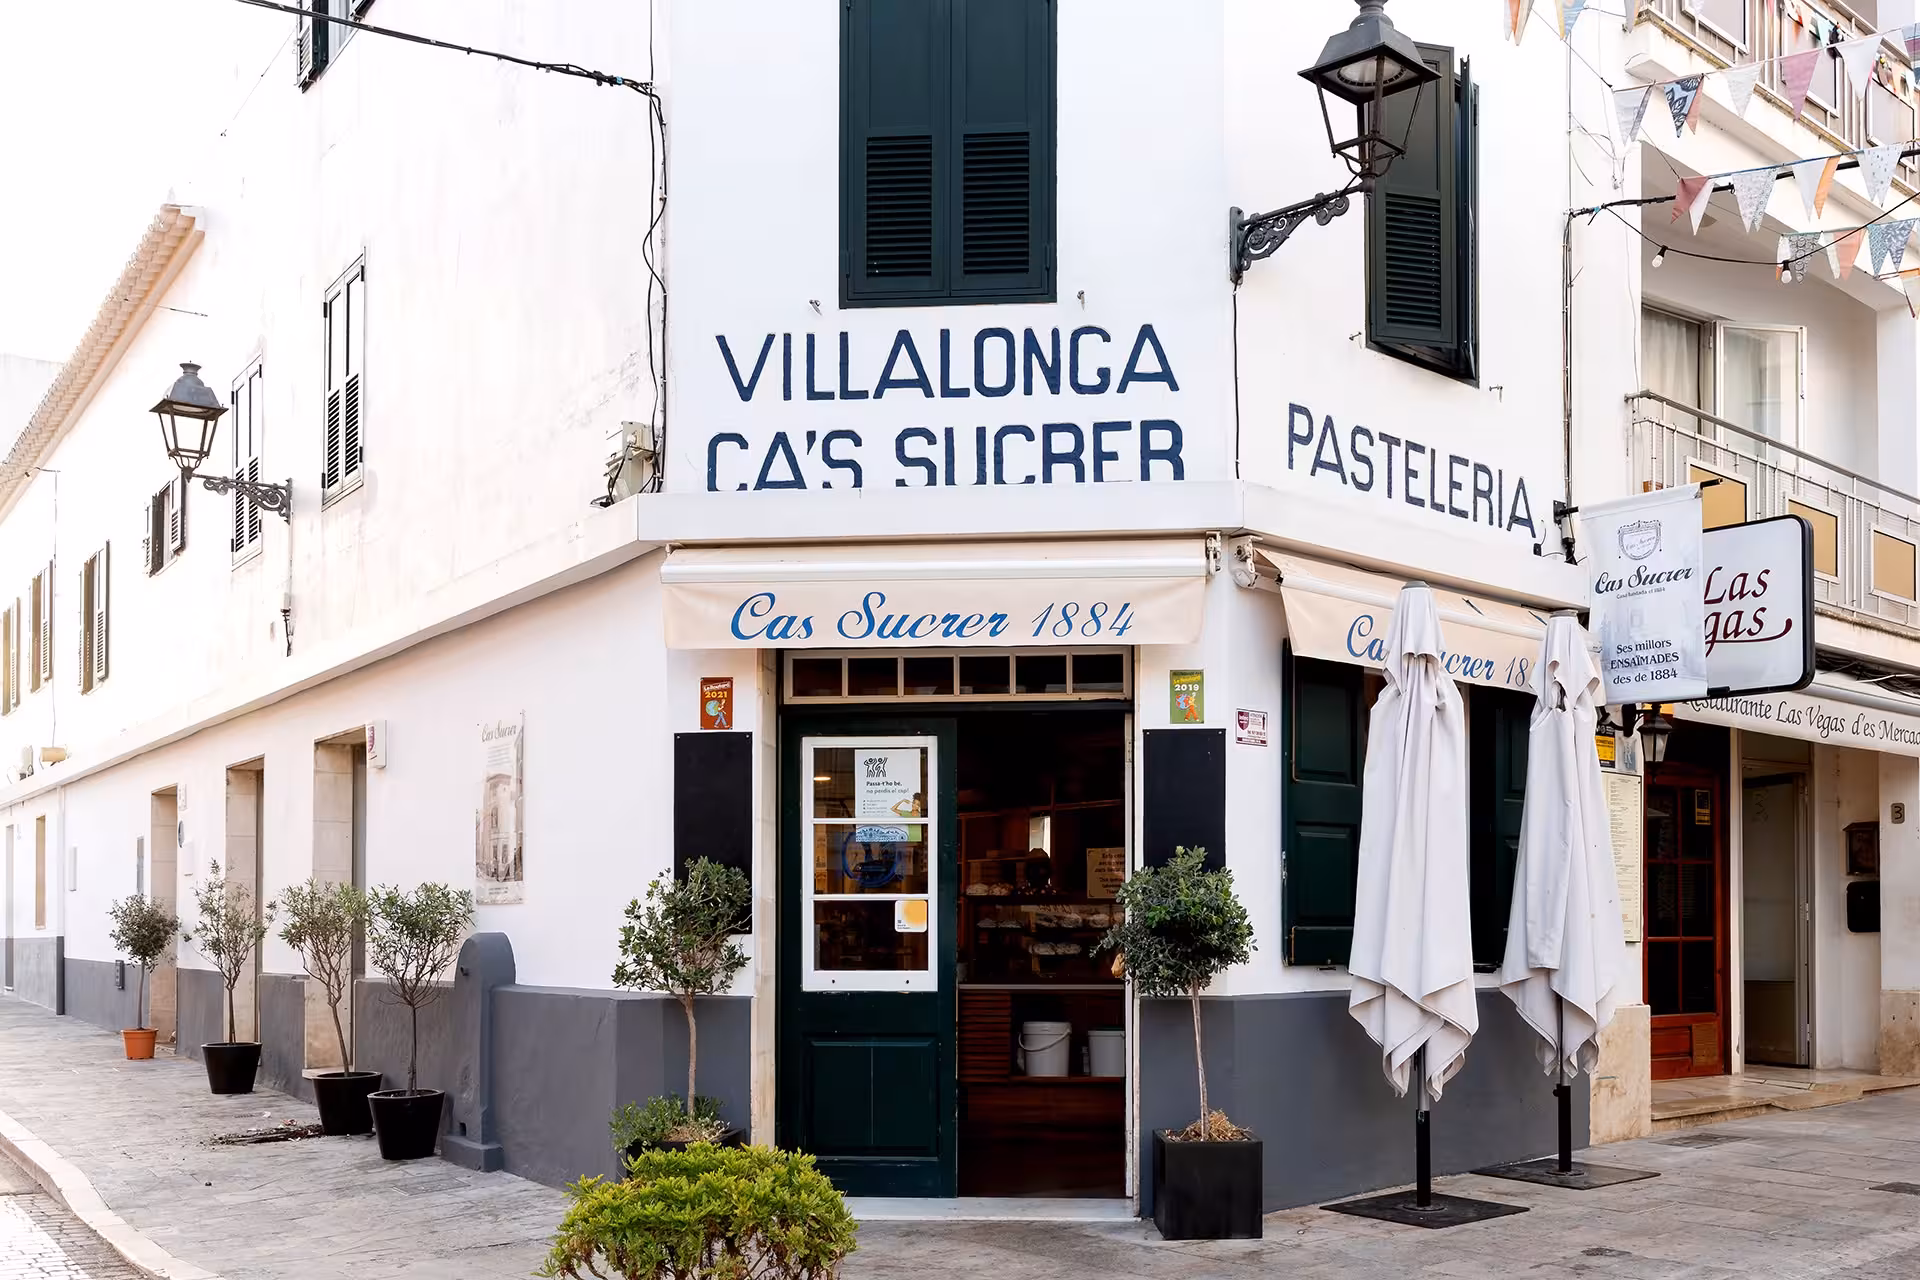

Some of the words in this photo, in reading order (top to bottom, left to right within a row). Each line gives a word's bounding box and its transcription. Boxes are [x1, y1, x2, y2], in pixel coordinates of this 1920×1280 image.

[715, 323, 1180, 402] VILLALONGA
[706, 429, 863, 491] CA'S
[895, 419, 1185, 486] SUCRER
[1287, 402, 1538, 539] PASTELERIA
[1594, 571, 1624, 594] Cas
[1627, 564, 1694, 588] Sucrer
[1703, 566, 1771, 605] Las
[729, 591, 815, 641] Cas
[836, 590, 1010, 641] Sucrer
[1030, 601, 1135, 638] 1884
[1704, 606, 1769, 658] gas
[1346, 614, 1388, 662] Ca
[1616, 643, 1633, 654] Ses
[1635, 638, 1672, 652] millors
[1613, 674, 1633, 685] des
[1634, 670, 1648, 682] de
[1650, 667, 1679, 681] 1884
[1775, 701, 1802, 726] Las
[1805, 705, 1846, 738] Vegas
[1851, 712, 1876, 738] d'es
[1893, 805, 1903, 820] 3
